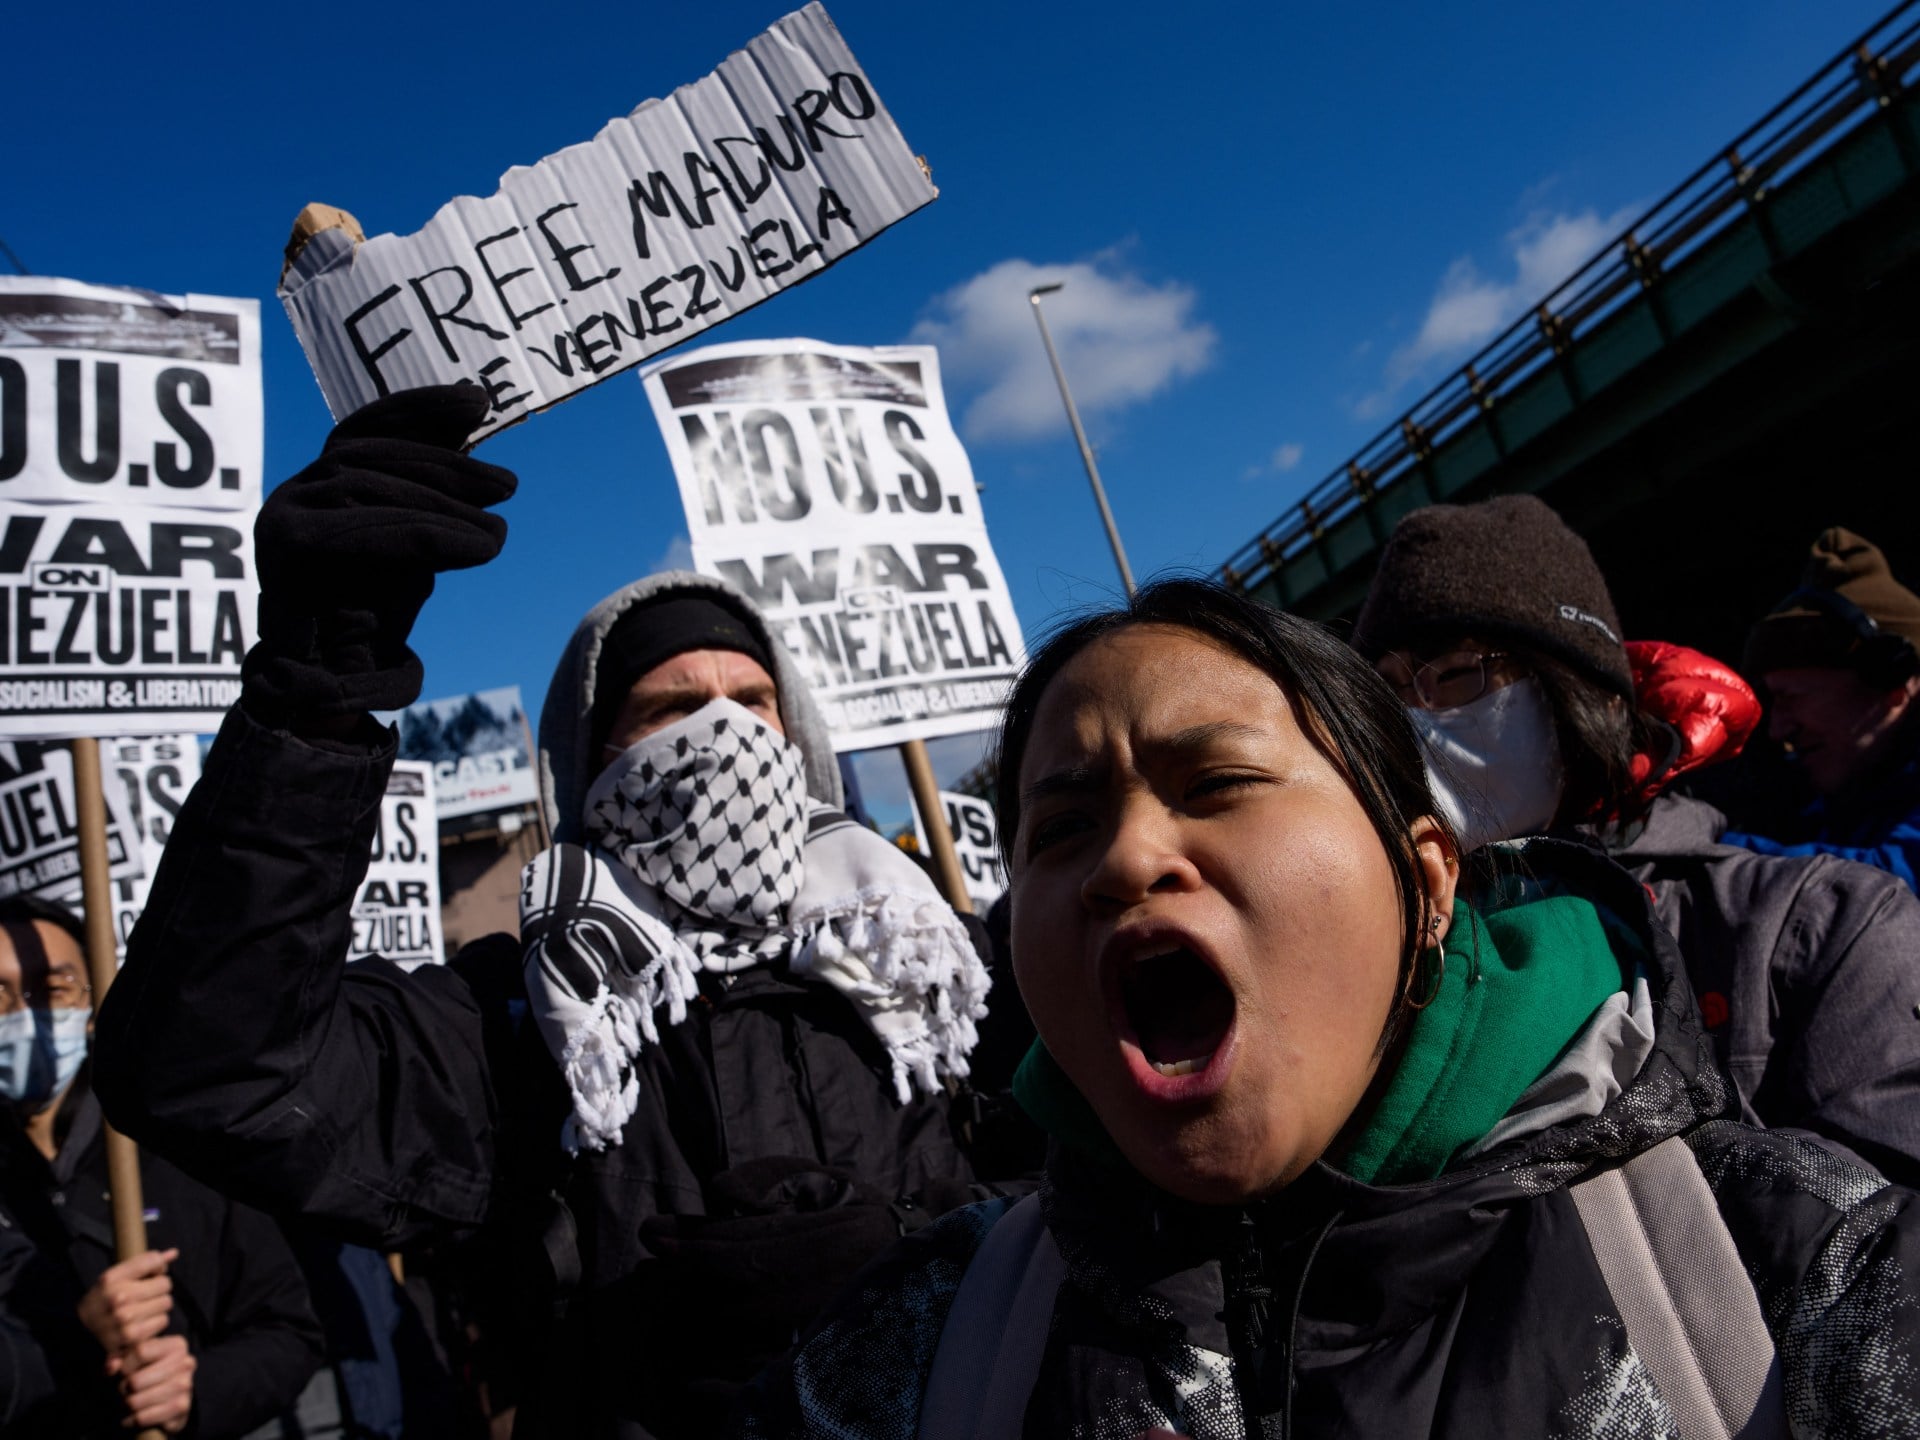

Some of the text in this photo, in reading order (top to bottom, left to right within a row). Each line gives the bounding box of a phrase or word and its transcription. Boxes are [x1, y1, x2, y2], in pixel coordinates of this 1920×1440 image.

[343, 71, 876, 396] FREE MADURO
[527, 187, 857, 376] VENEZUELA
[56, 358, 241, 491] U.S.
[679, 406, 964, 526] NO U.S.
[39, 568, 100, 586] ON
[714, 543, 990, 606] WAR
[0, 585, 247, 666] EZUELA
[107, 681, 136, 708] &
